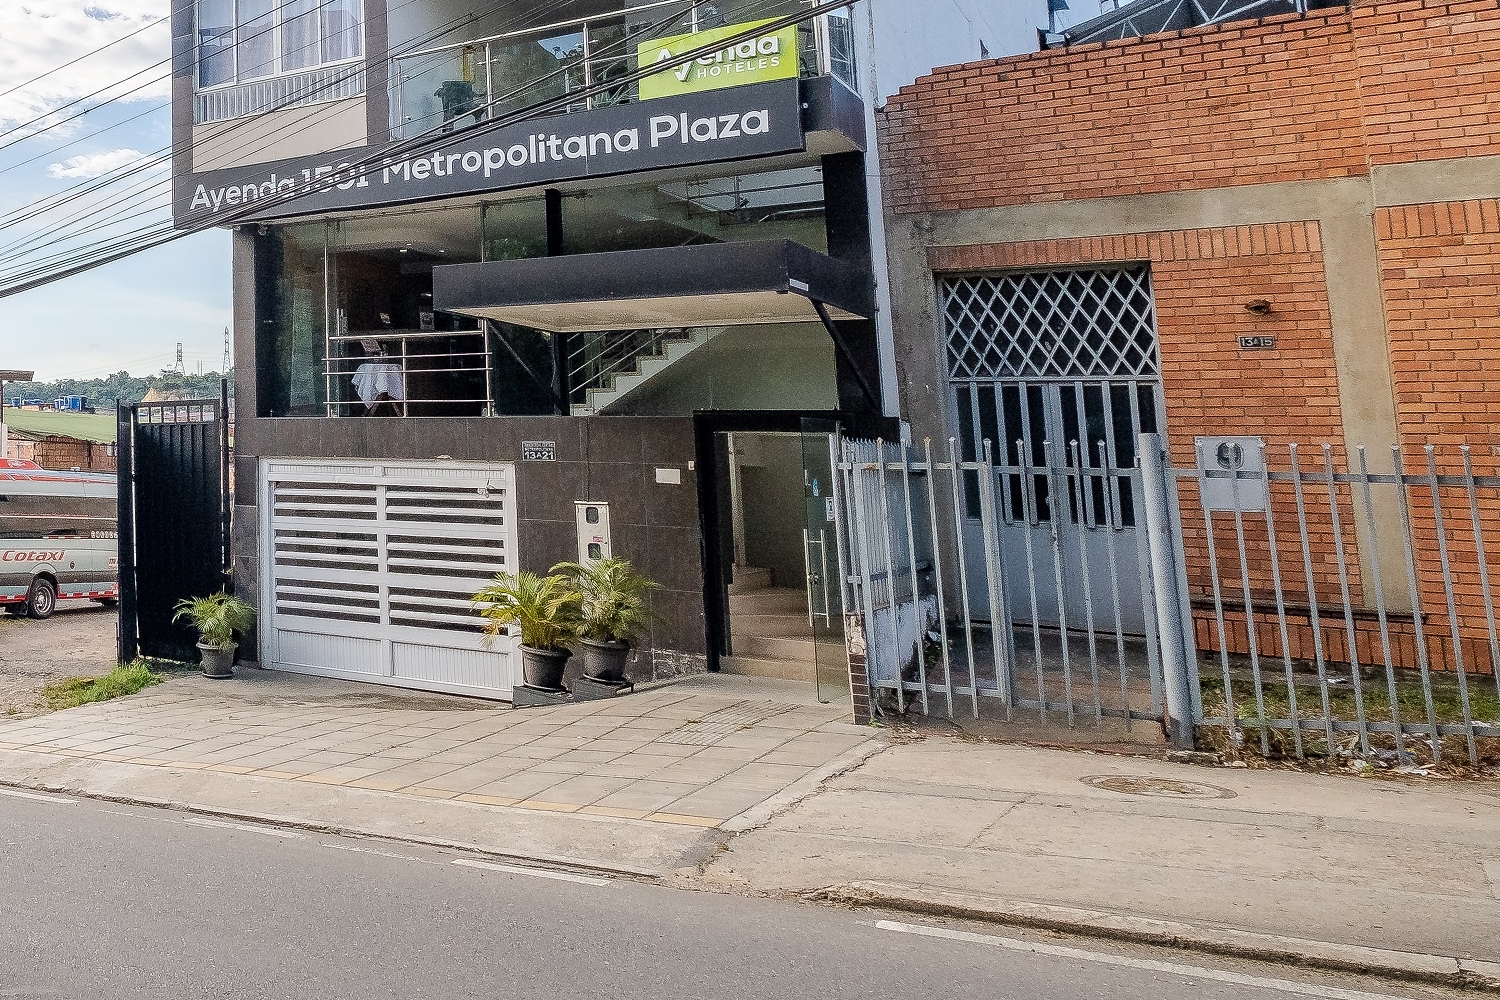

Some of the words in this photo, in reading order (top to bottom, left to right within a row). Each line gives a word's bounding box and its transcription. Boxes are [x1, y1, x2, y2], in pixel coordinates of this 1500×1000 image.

[697, 57, 780, 79] HOTELES
[189, 173, 295, 213] Ayenda
[382, 128, 639, 184] Metropolitana
[650, 109, 769, 147] Plaza
[524, 451, 554, 460] 13A21
[2, 549, 66, 561] Cotaxi
